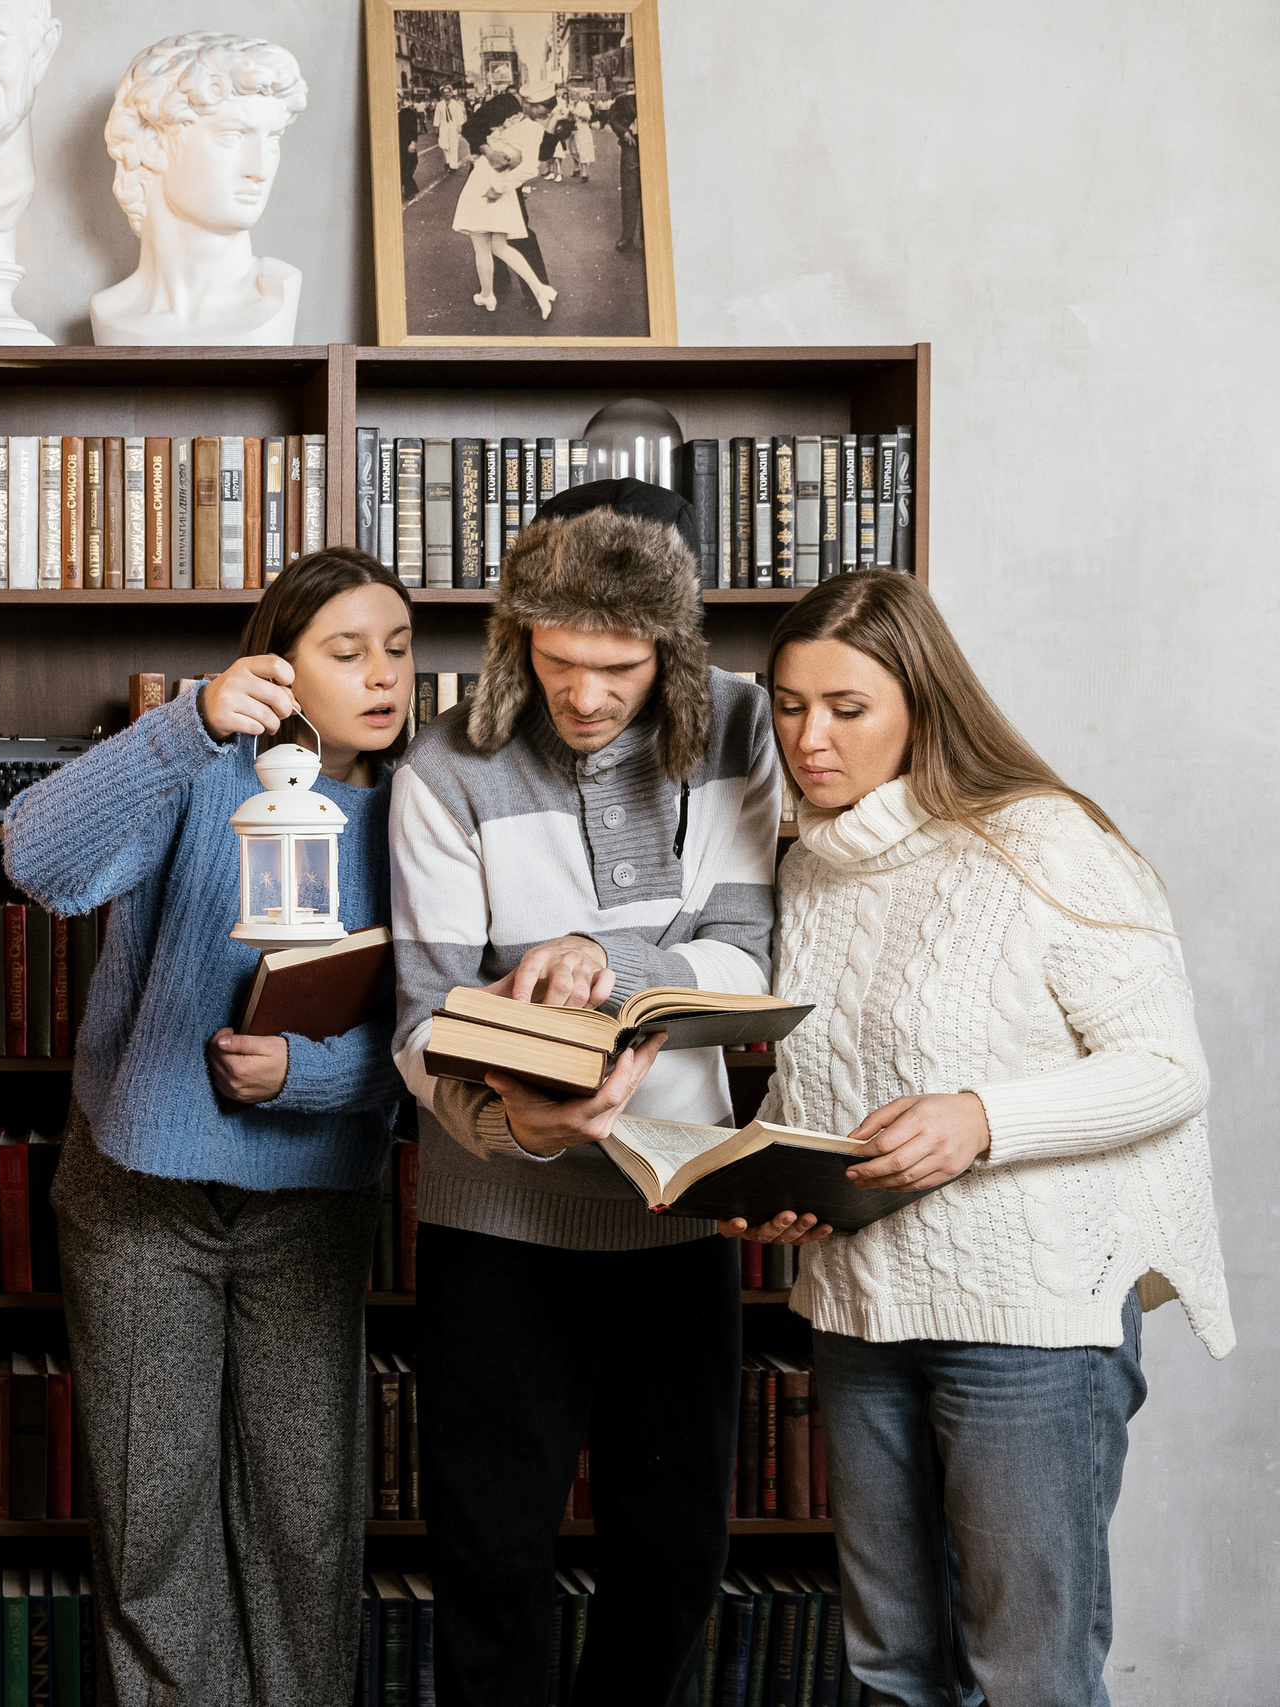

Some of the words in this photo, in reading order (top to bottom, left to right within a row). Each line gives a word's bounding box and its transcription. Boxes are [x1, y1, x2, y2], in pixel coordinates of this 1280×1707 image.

[67, 454, 77, 509] СИМОНОВ
[153, 455, 163, 510] СИМОНОВ
[382, 451, 391, 501] М.ГОРЬКИЙ
[487, 451, 496, 501] М.ГОРЬКИЙ
[511, 458, 519, 491] НАБОКОВ
[525, 451, 534, 501] М.ГОРЬКИЙ
[758, 451, 769, 501] М.ГОРЬКИЙ
[823, 448, 837, 497] ШУКШИН
[845, 449, 856, 499] М.ГОРЬКИЙ
[881, 449, 893, 500] М.ГОРЬКИЙ
[90, 490, 98, 528] РАССКАЗЫ
[823, 498, 837, 541] Василий
[67, 510, 77, 563] Константин
[153, 510, 163, 564] Константин
[152, 566, 163, 581] 2
[489, 568, 495, 576] 5
[761, 568, 767, 576] 6
[827, 563, 833, 574] 1
[767, 1403, 776, 1447] ФАДЕЕВ
